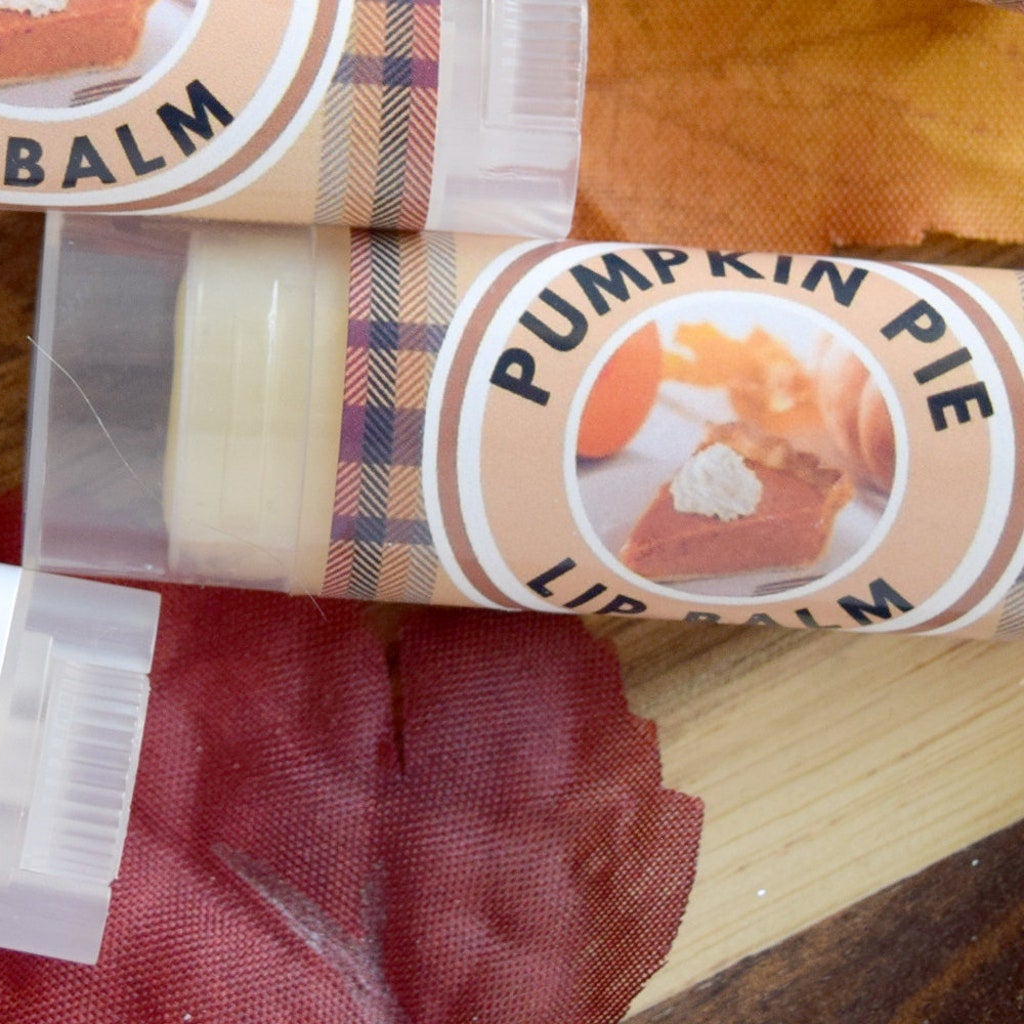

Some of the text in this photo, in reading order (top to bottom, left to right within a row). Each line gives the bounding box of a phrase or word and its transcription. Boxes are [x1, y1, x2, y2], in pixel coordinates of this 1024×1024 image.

[3, 79, 235, 189] BALM
[489, 248, 995, 432] PUMPKIN PIE
[525, 557, 648, 615] LIP
